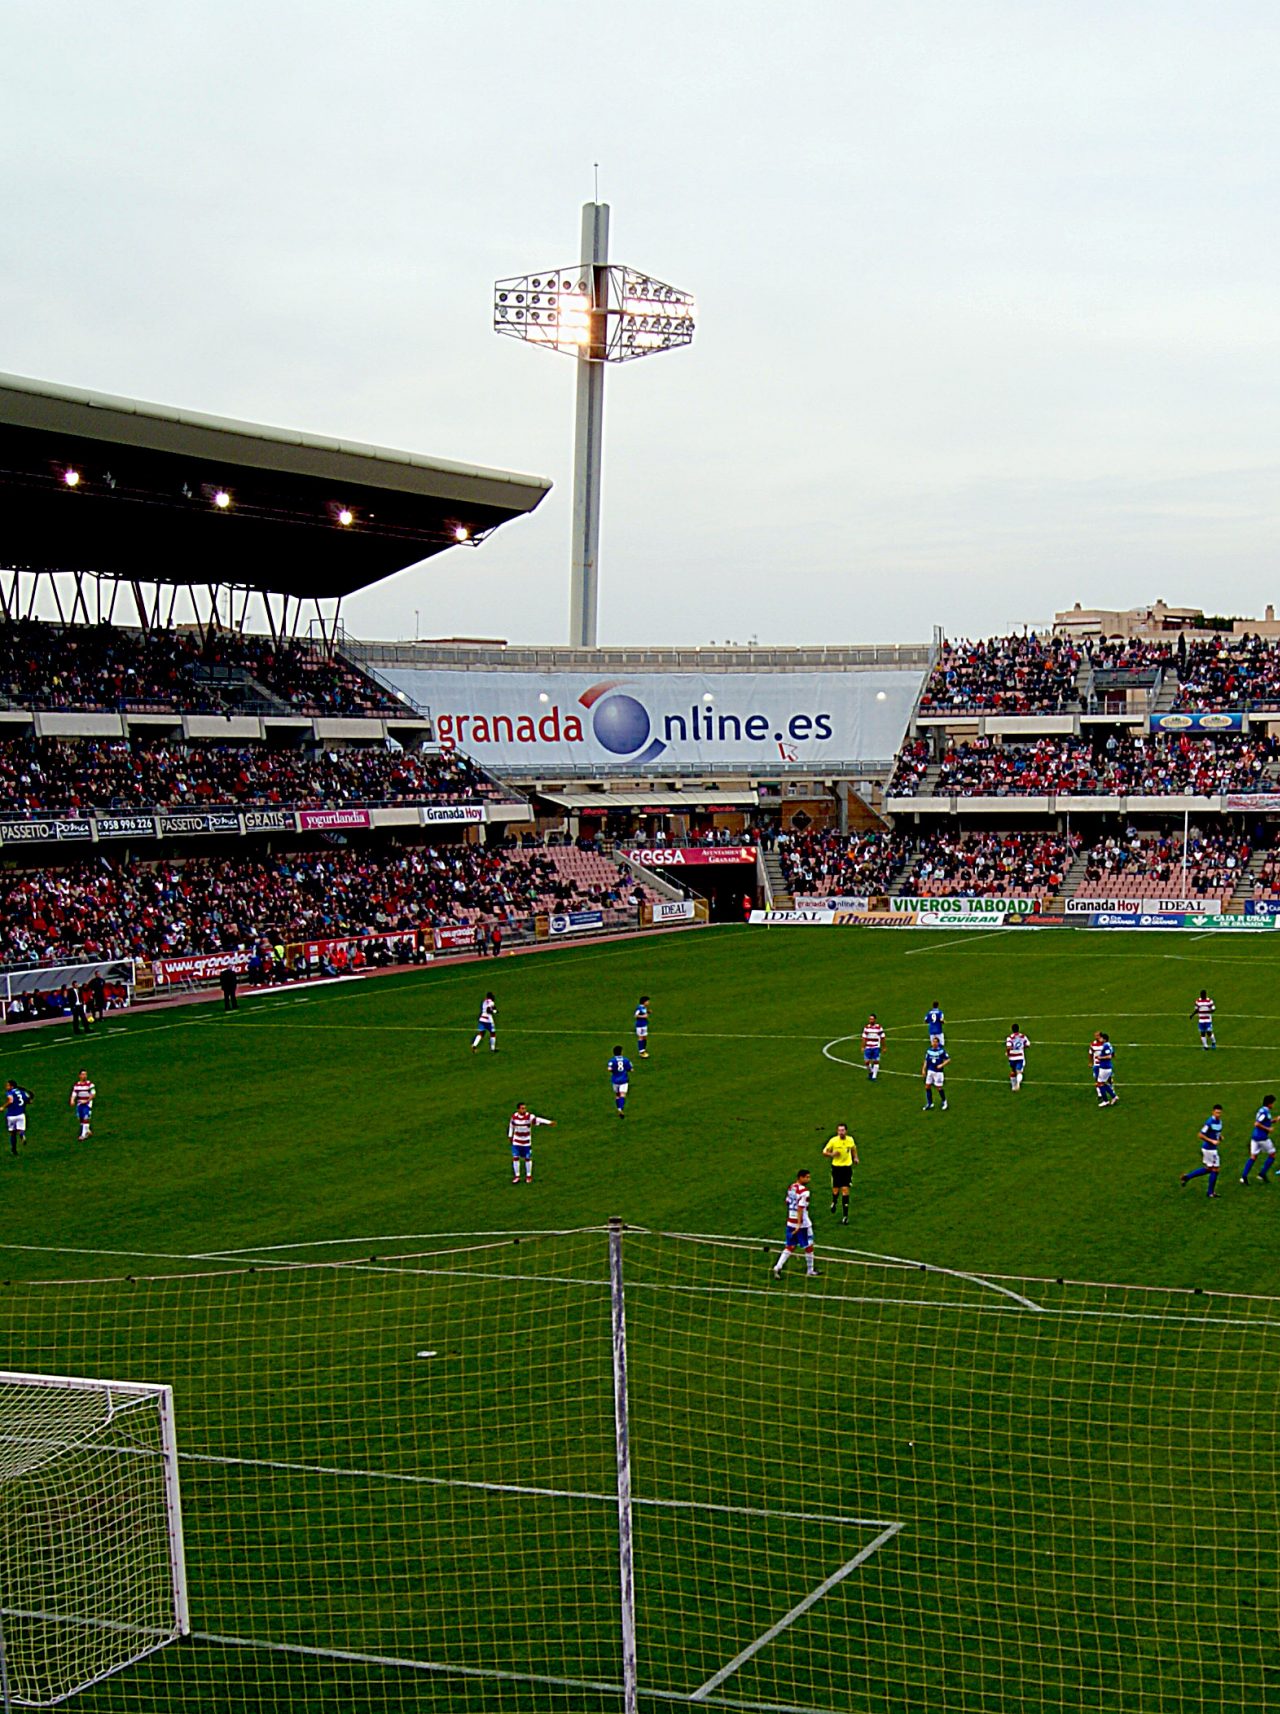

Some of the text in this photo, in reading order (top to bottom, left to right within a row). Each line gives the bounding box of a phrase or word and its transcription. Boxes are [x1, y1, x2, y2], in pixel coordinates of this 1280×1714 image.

[437, 705, 584, 751] granada
[245, 814, 285, 827] GRATIS
[306, 812, 365, 829] yogurtlandia
[427, 807, 482, 821] Granada Hoy
[103, 818, 153, 830] 958 996 226
[161, 817, 203, 832] PASSETTO
[1, 823, 49, 840] PASSETTO
[661, 903, 687, 916] IDEAL
[894, 899, 961, 913] VIVEROS
[1067, 899, 1140, 914] Granada Hoy
[1159, 901, 1206, 911] IDEAL
[763, 911, 822, 921] IDEAL
[931, 1013, 937, 1024] 9
[617, 1061, 624, 1072] 8
[17, 1094, 24, 1106] 3
